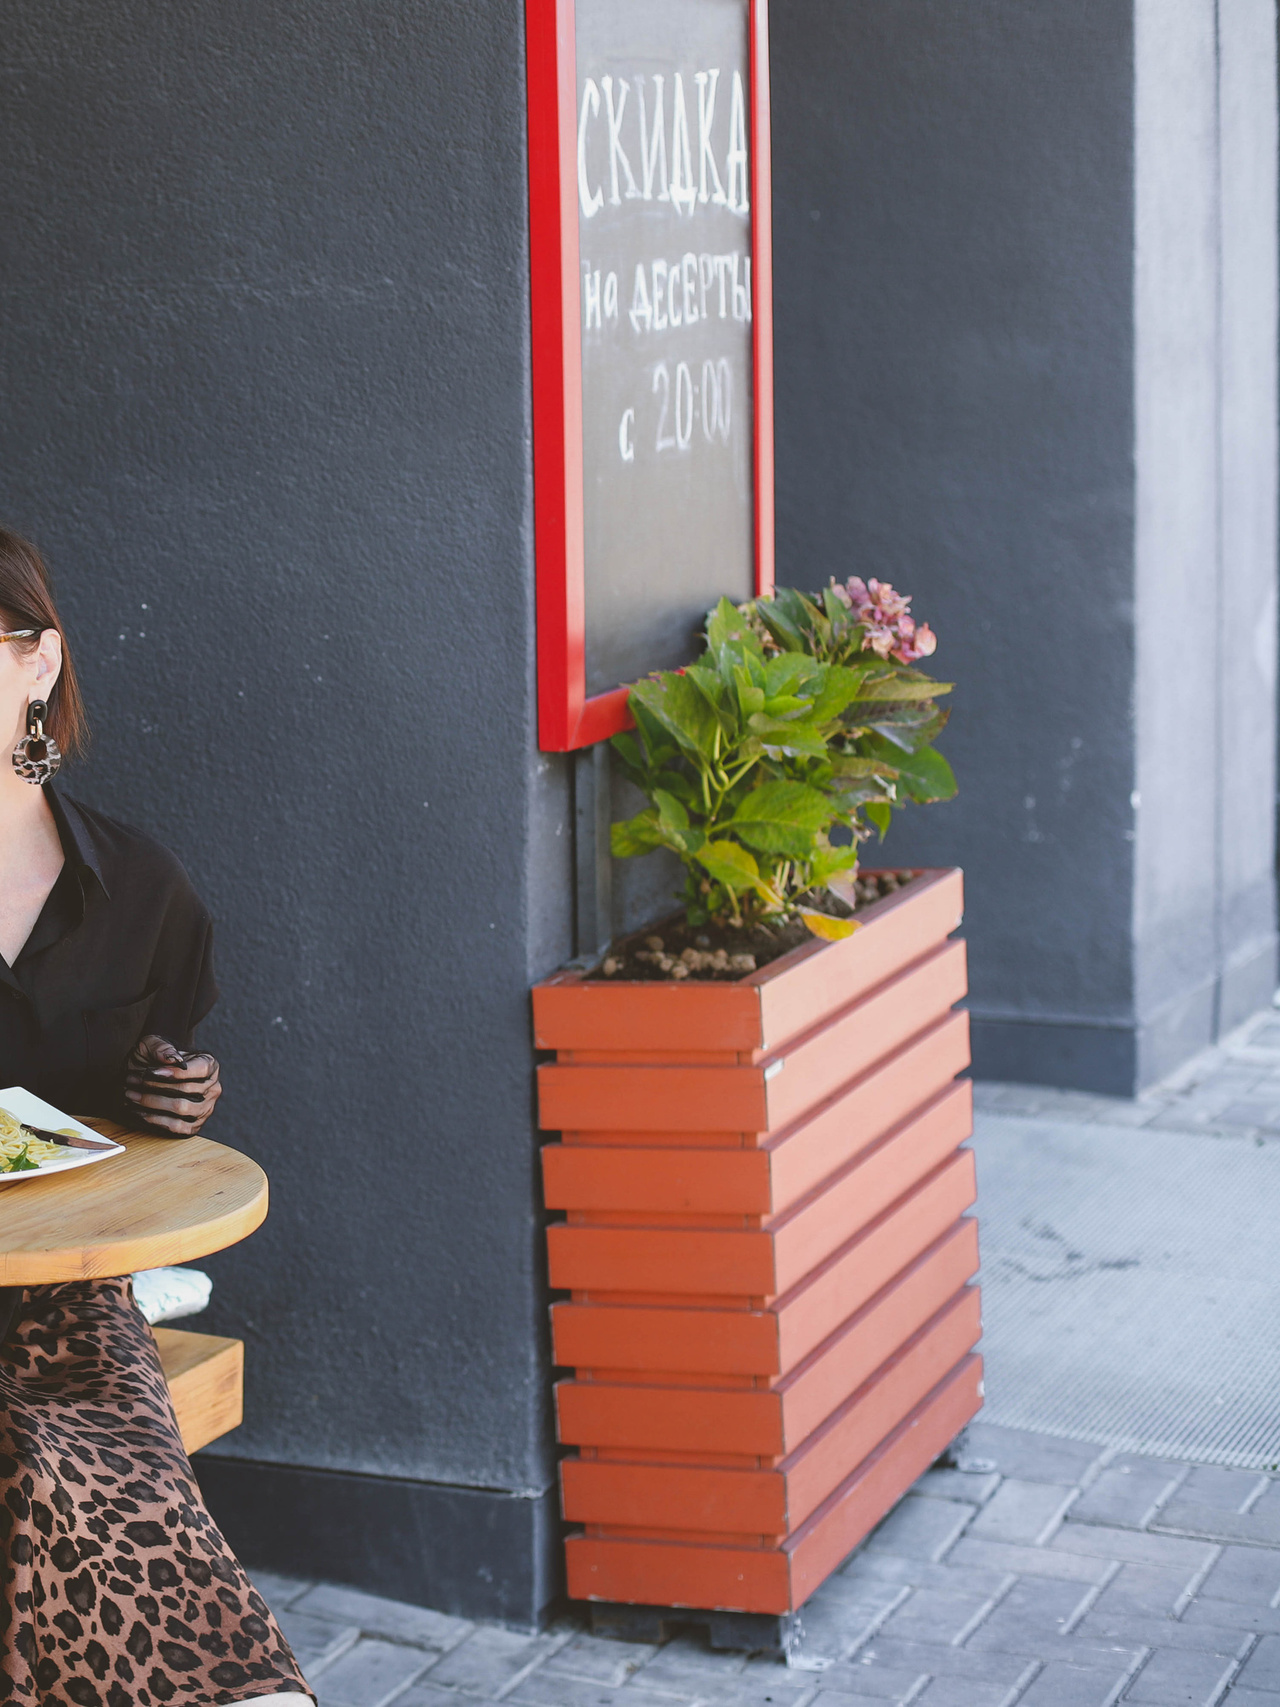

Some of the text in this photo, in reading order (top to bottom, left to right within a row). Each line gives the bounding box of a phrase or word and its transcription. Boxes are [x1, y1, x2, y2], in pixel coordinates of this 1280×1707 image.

[577, 69, 750, 218] СКИДКА
[629, 252, 752, 333] ДЕСЕРТЫ
[652, 358, 732, 451] 20:00
